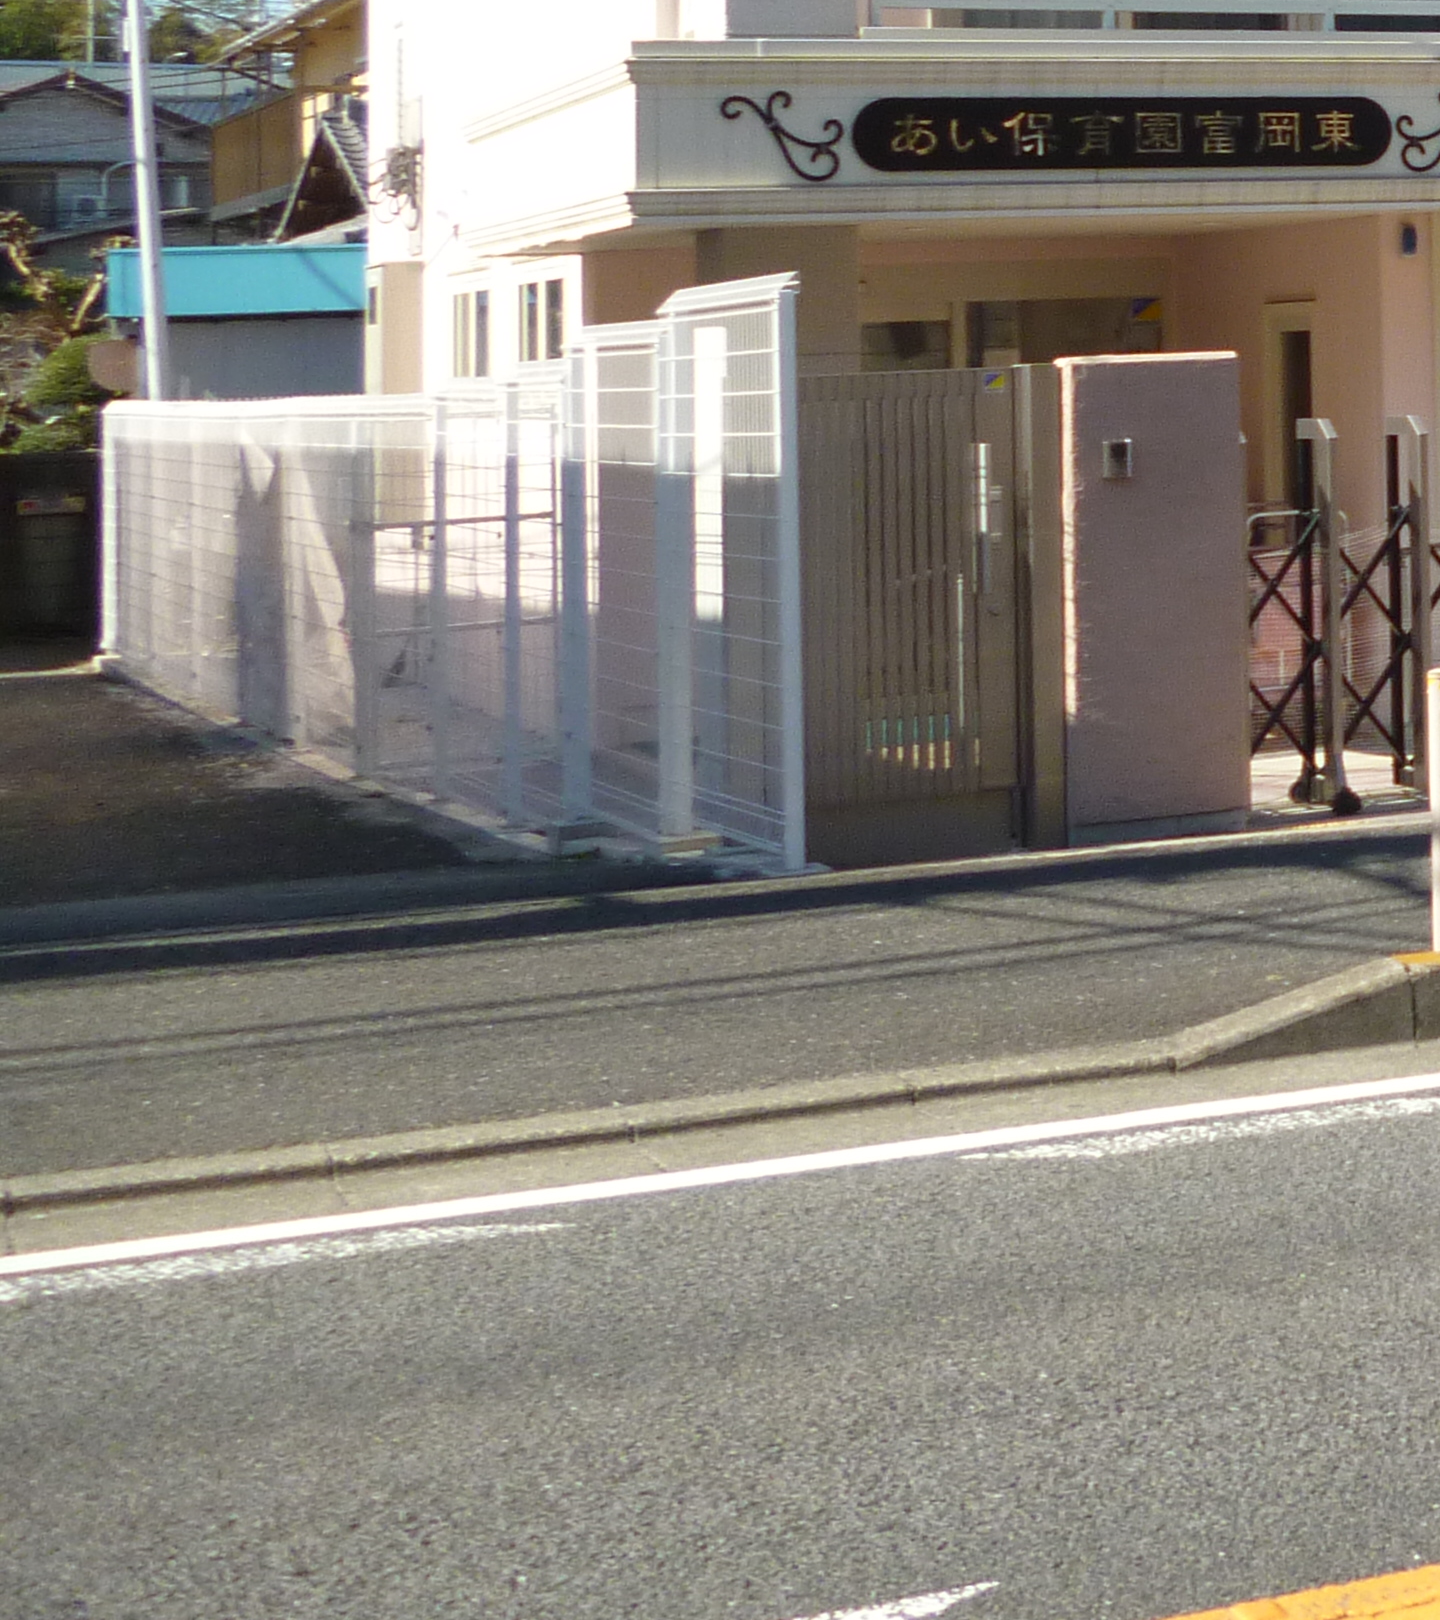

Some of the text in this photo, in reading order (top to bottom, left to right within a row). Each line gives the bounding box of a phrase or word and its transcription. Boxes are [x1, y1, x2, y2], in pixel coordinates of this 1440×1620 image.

[889, 109, 1362, 157] あい保育園富岡東
